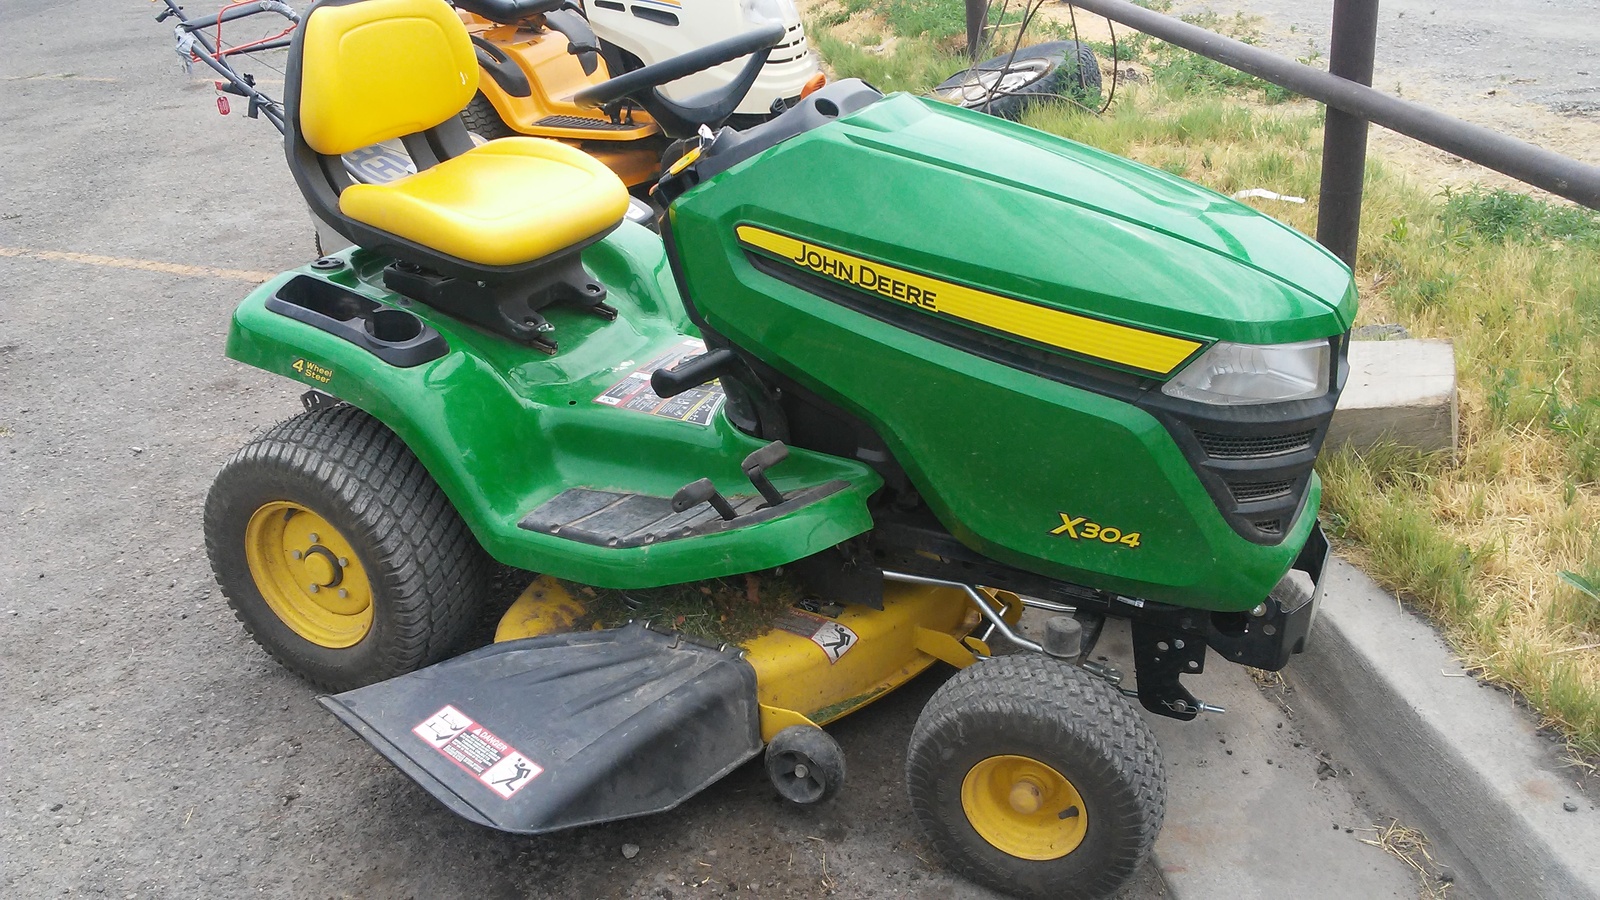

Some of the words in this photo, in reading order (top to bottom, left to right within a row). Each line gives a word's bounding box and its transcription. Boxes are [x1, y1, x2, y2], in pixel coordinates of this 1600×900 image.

[794, 244, 854, 282] JOHN
[859, 264, 937, 310] DEERE
[292, 359, 304, 373] 4
[306, 361, 333, 377] Wheel
[305, 369, 331, 383] Steer
[1049, 511, 1141, 548] X304
[479, 731, 508, 753] DANGER
